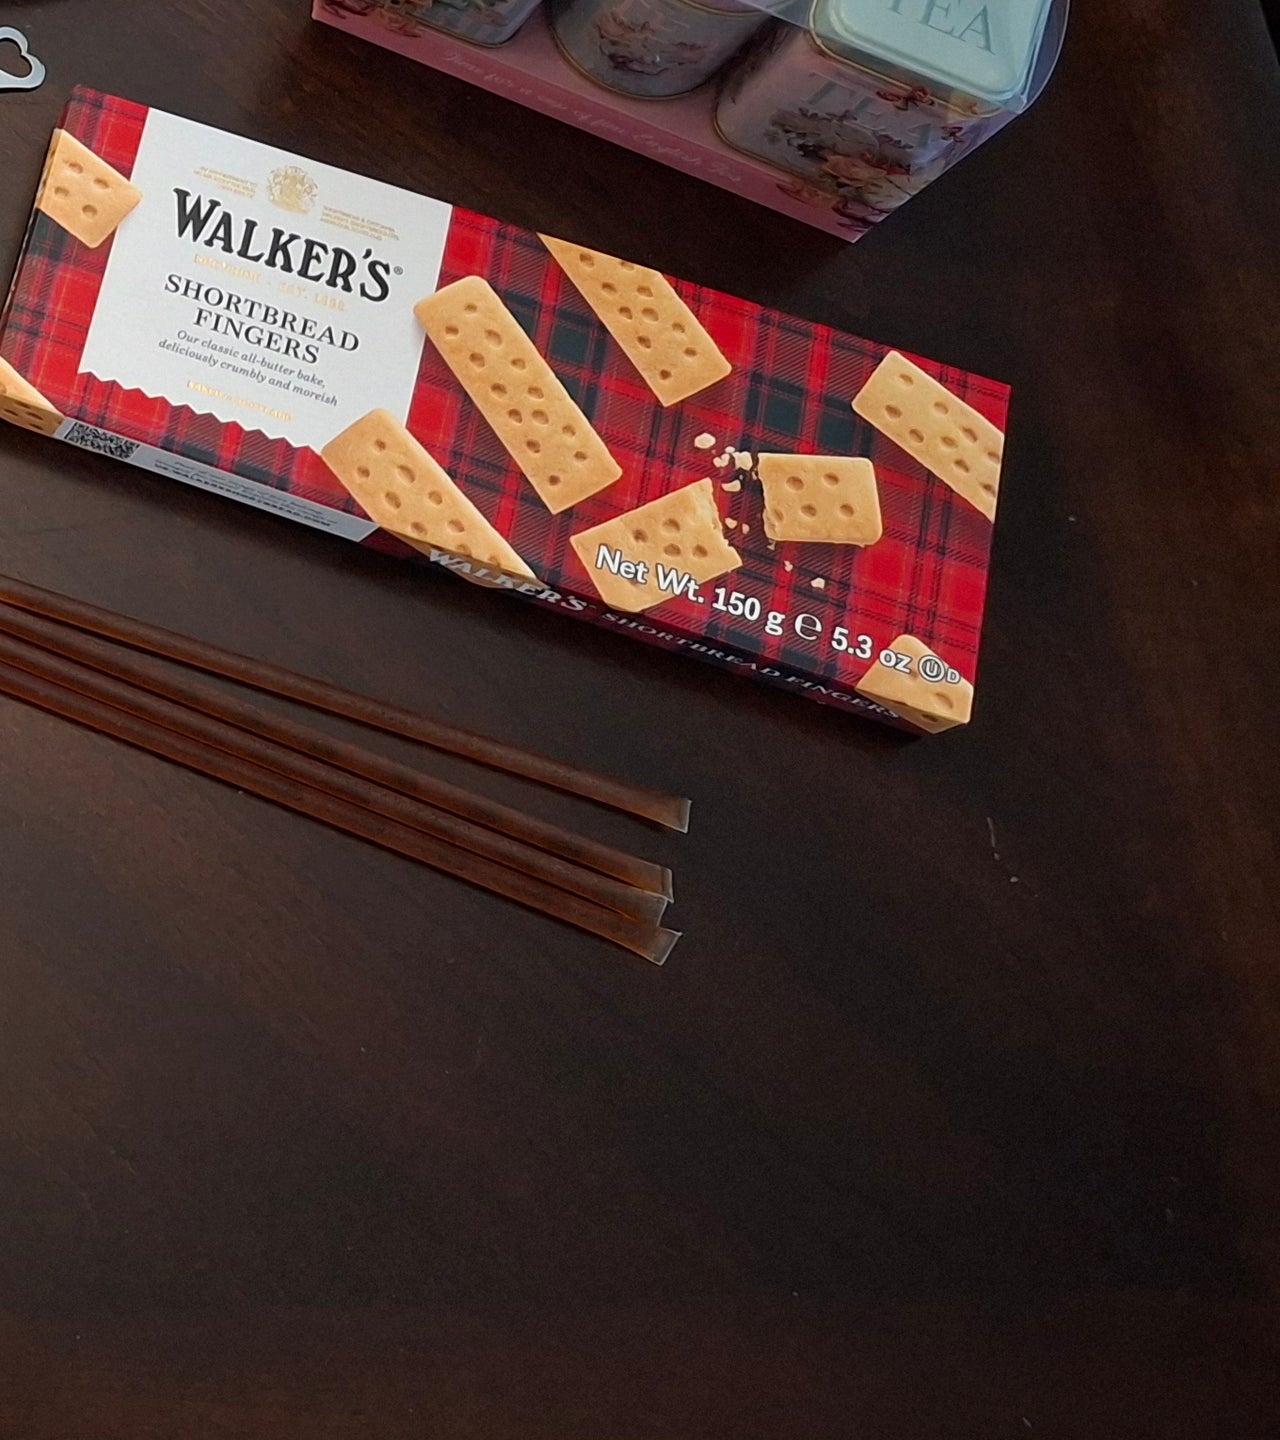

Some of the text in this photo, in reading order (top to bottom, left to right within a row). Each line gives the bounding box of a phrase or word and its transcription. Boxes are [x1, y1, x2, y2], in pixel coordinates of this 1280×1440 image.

[164, 273, 360, 352] SHORTBREAD
[193, 307, 320, 365] FINGERS
[158, 339, 218, 367] deliciously
[220, 357, 266, 384] crumbly
[268, 372, 290, 391] and
[292, 383, 338, 407] moreish
[177, 329, 326, 389] Our classic all-butter bake,
[429, 548, 588, 611] WALKER'S
[597, 544, 647, 584] Net
[654, 566, 705, 605] Wt.
[711, 586, 761, 621] 150
[765, 607, 786, 637] g
[831, 626, 874, 661] 5.3
[878, 648, 913, 674] oz
[602, 612, 900, 720] SHORTBREAD FINGERS
